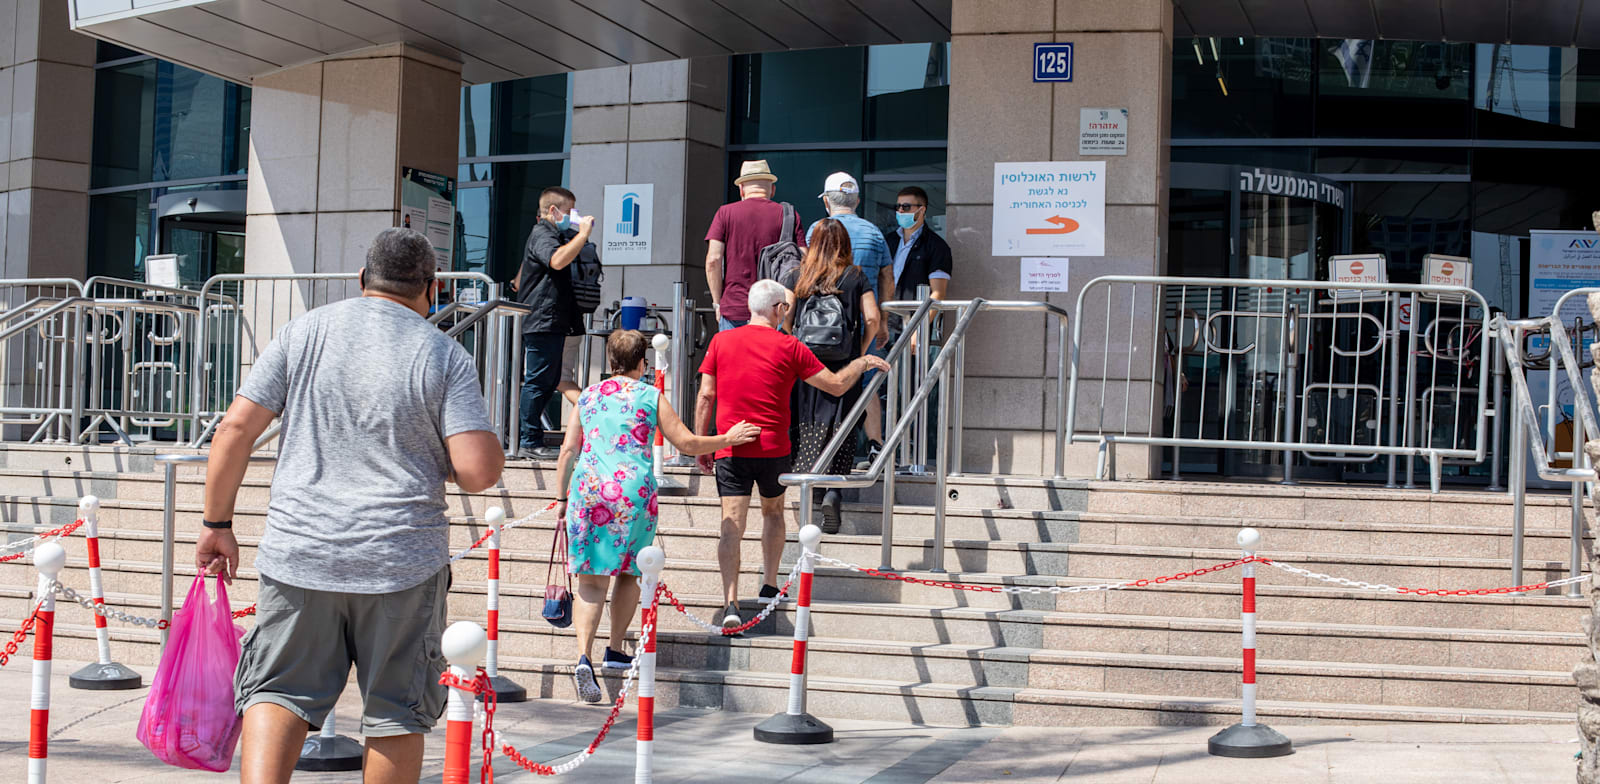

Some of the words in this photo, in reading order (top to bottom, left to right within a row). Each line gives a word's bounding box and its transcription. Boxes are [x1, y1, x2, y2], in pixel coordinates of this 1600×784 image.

[1040, 52, 1067, 74] 125
[1001, 171, 1055, 185] האוכלוסין
[1059, 170, 1097, 182] לרשות
[1240, 168, 1318, 199] הממשלה
[1028, 186, 1055, 196] לגשת
[1057, 187, 1069, 196] נא
[1009, 200, 1052, 209] האחורית.
[1055, 199, 1087, 209] לכניסה
